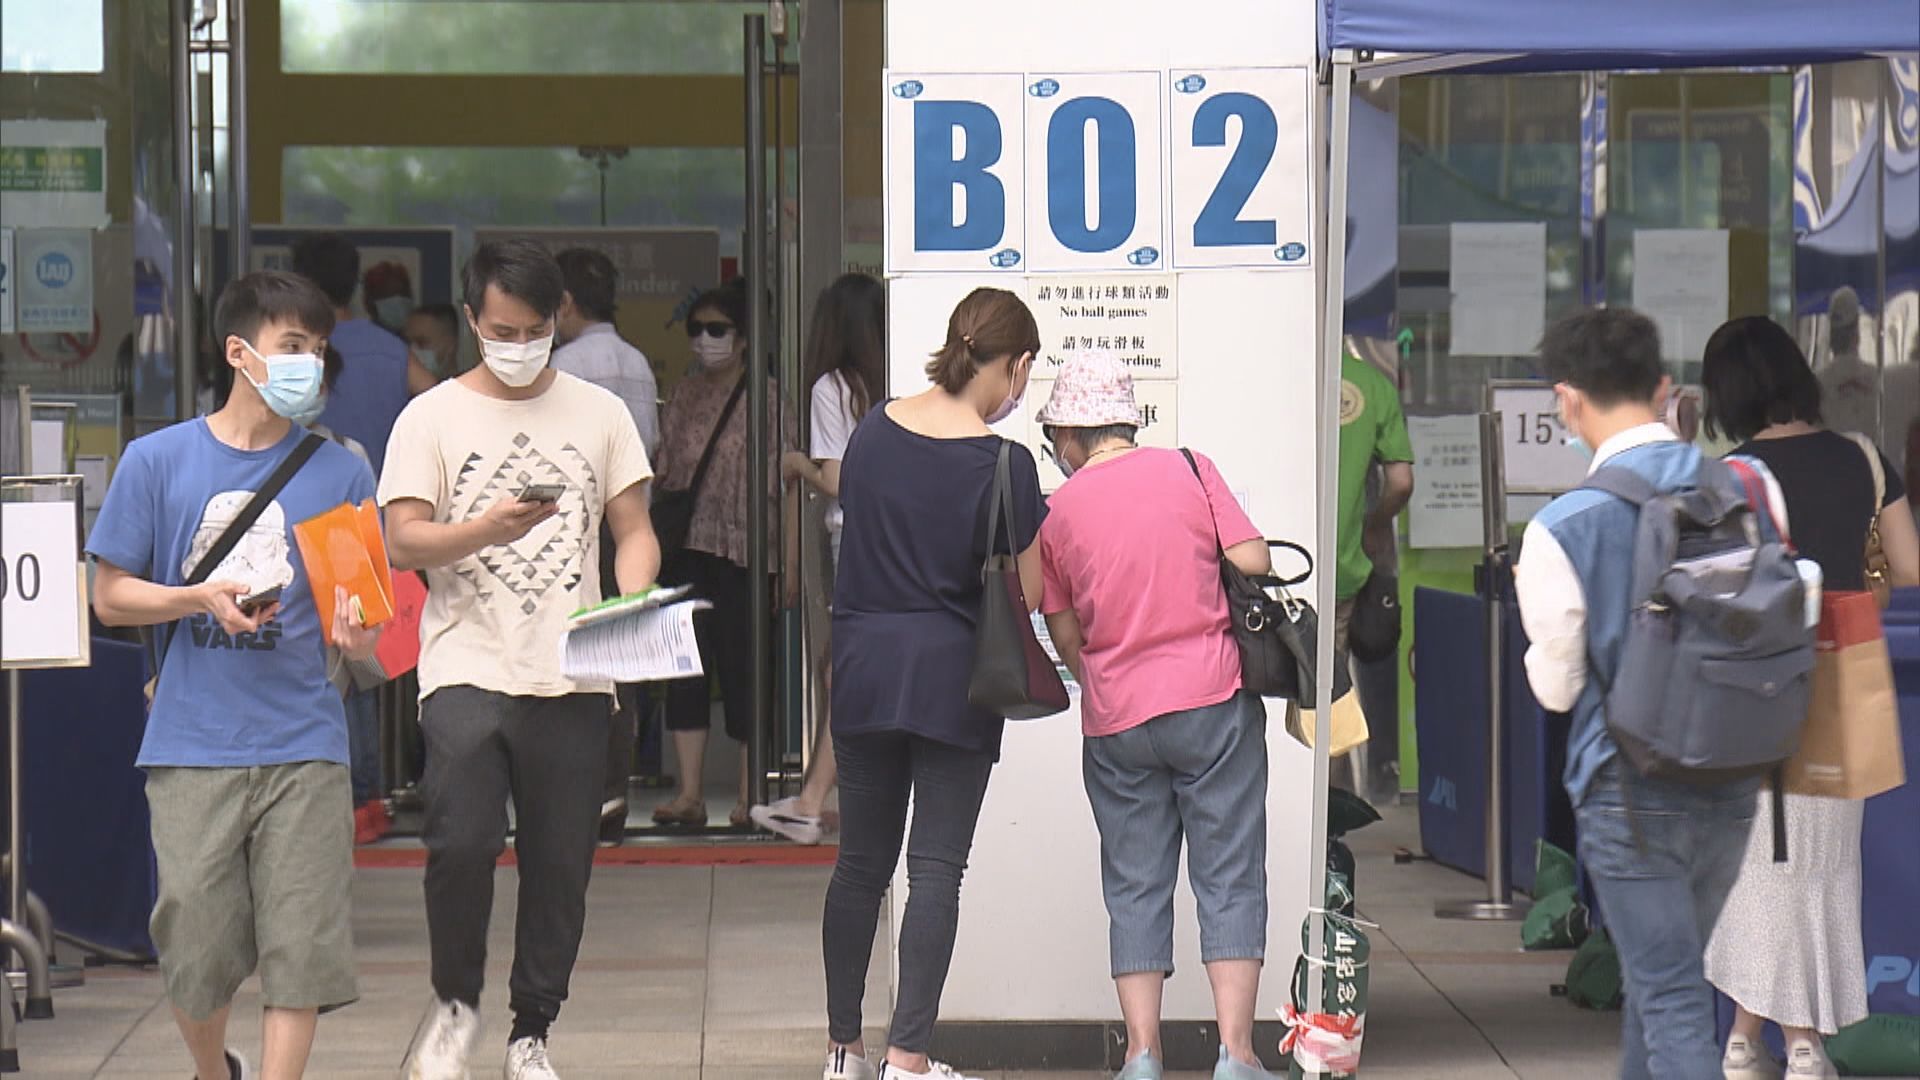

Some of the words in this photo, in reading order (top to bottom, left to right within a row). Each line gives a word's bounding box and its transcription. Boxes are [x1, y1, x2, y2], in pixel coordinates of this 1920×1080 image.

[1038, 285, 1169, 300] 請勿進行球類活動
[1060, 306, 1077, 317] No
[1081, 306, 1105, 317] ball
[1108, 308, 1148, 319] games
[1062, 336, 1145, 350] 請勿玩滑板
[1046, 354, 1065, 367] No
